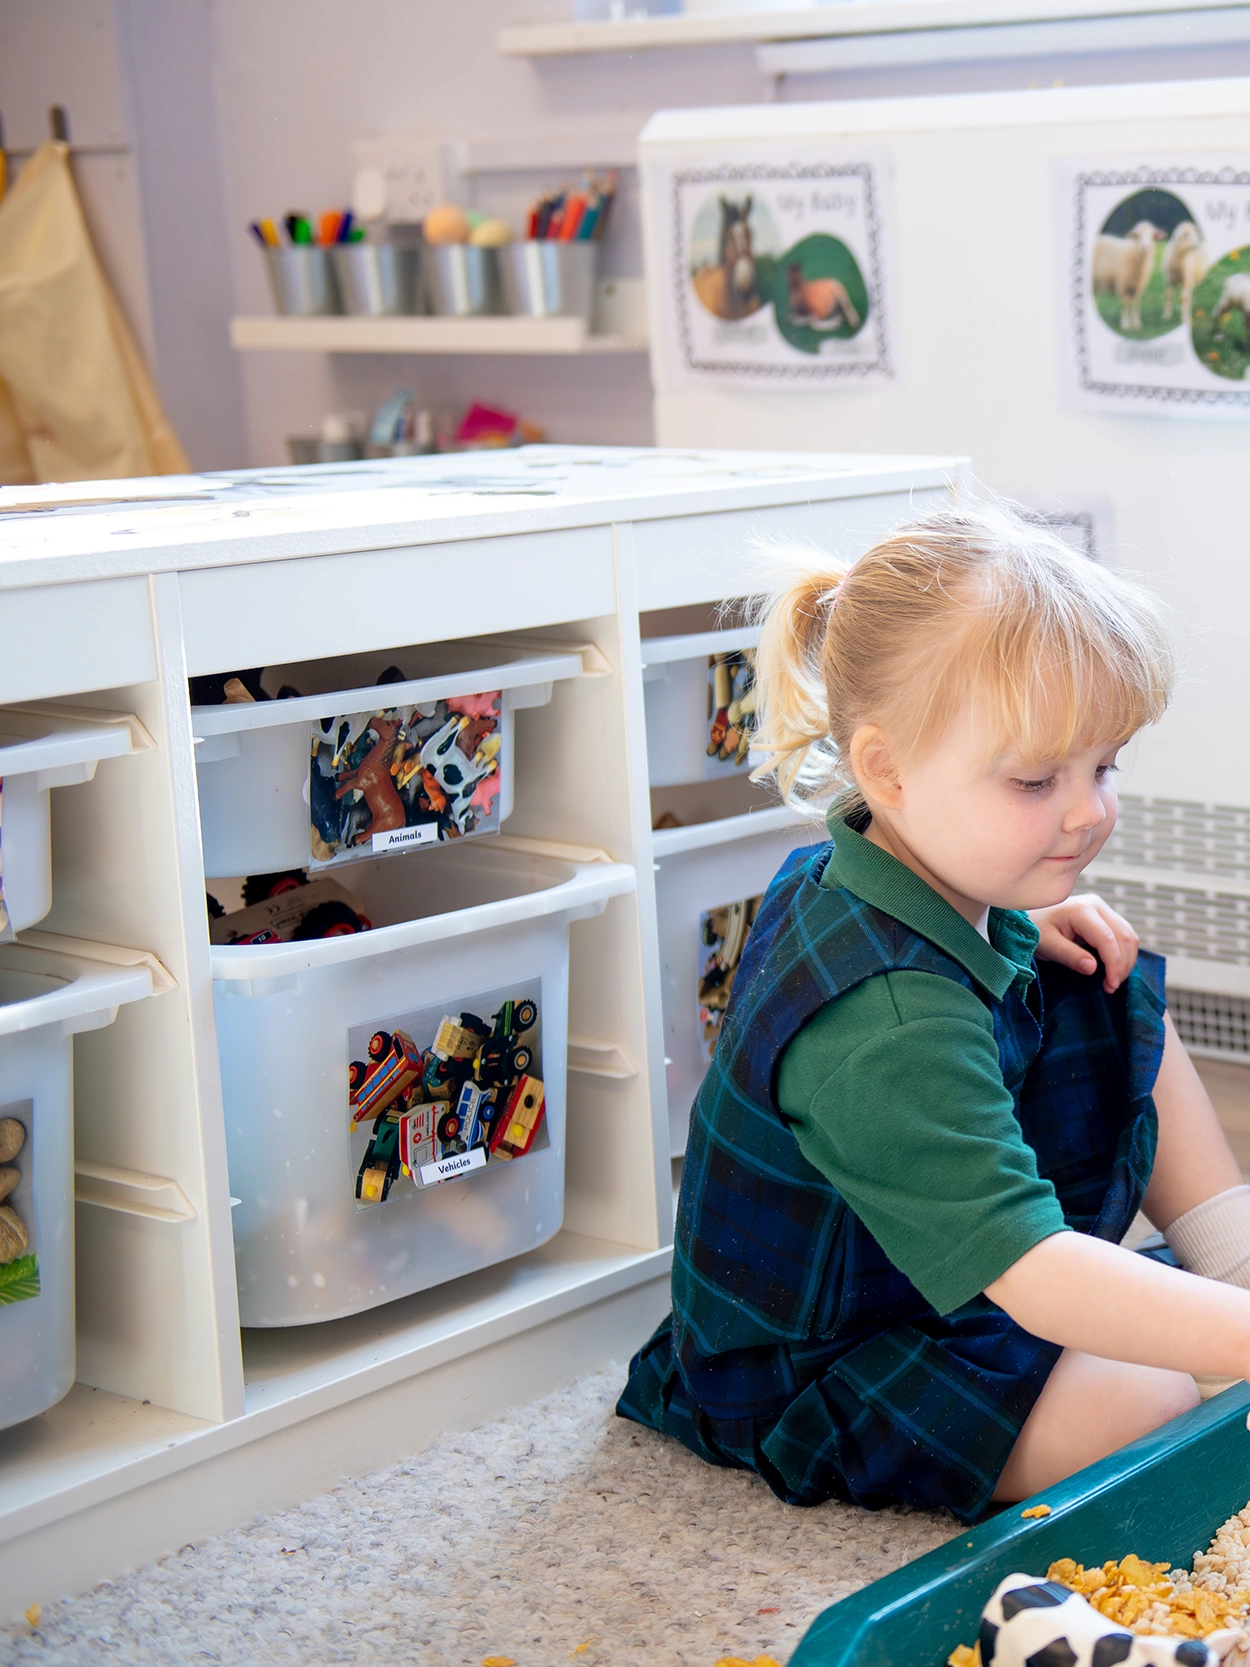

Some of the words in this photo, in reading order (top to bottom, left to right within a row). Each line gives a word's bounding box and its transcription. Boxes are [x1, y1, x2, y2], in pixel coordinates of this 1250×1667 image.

[1204, 199, 1238, 228] My
[388, 830, 422, 844] Animals
[463, 1097, 477, 1131] POLICE
[437, 1158, 472, 1175] Vehicles
